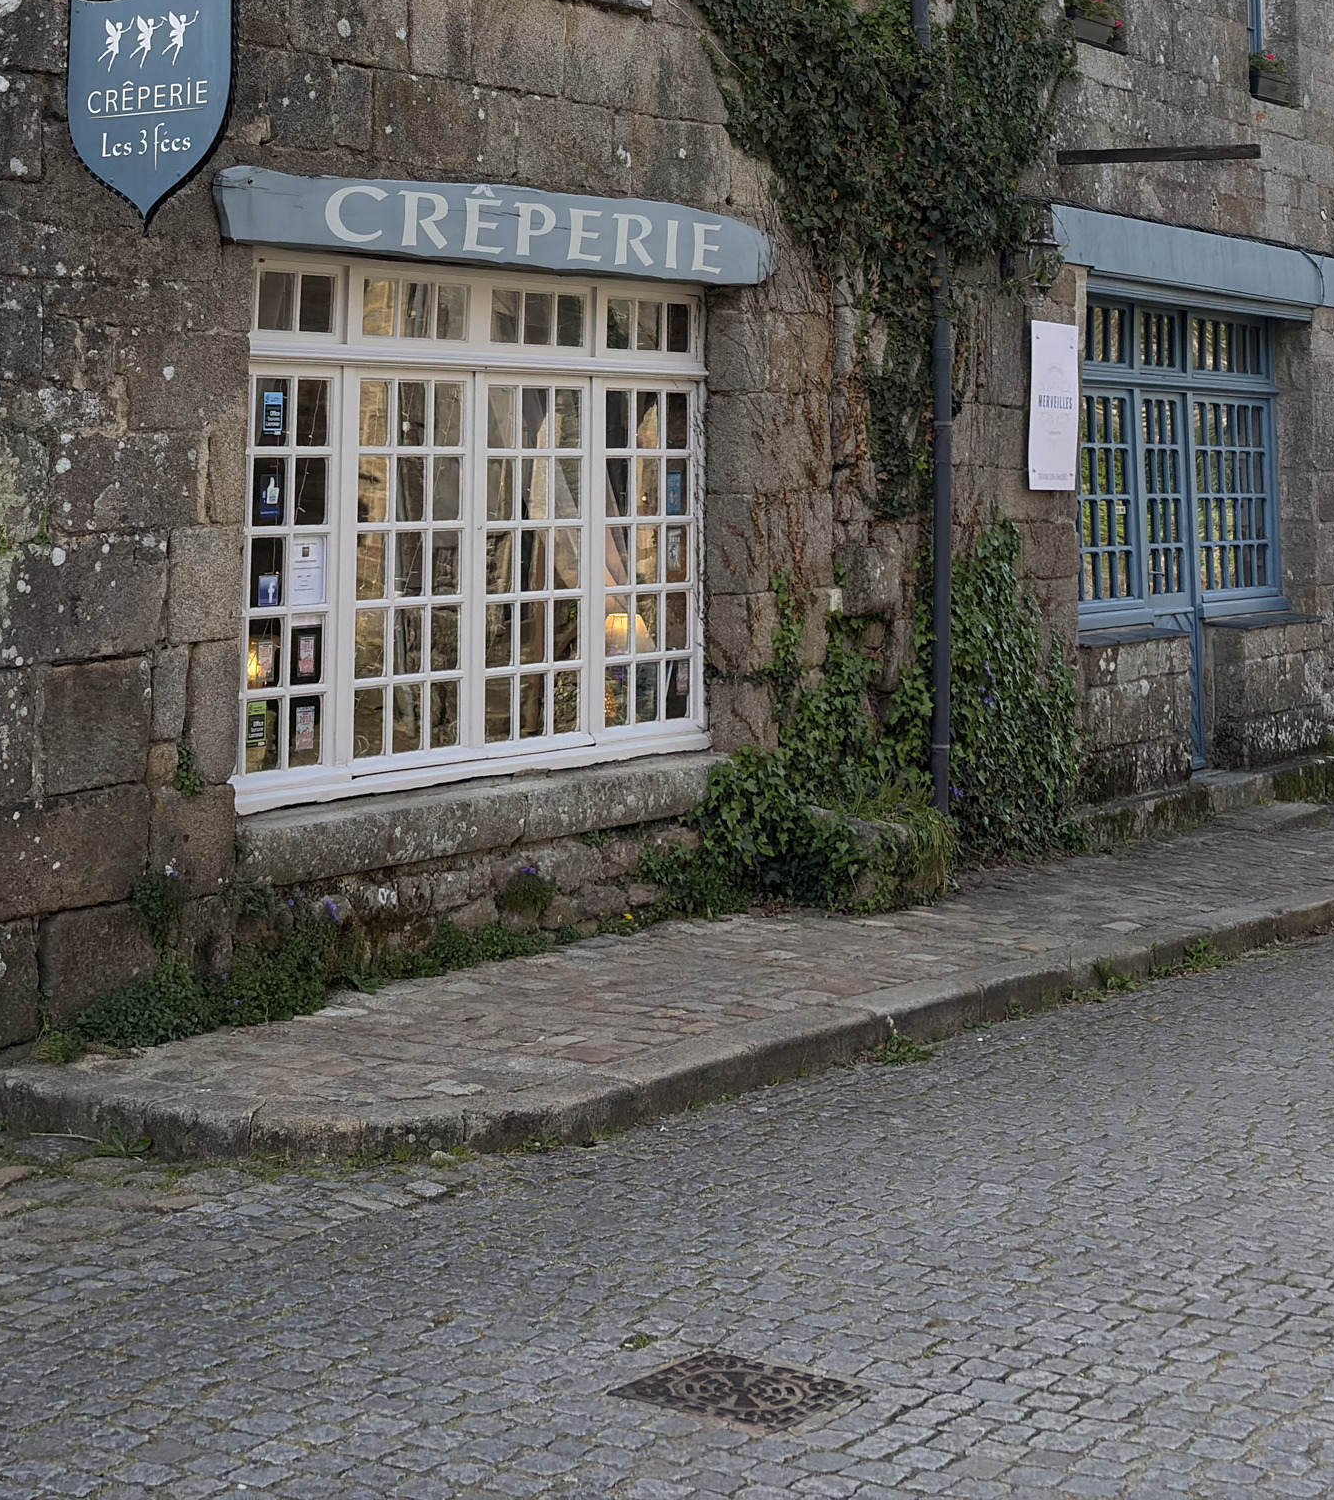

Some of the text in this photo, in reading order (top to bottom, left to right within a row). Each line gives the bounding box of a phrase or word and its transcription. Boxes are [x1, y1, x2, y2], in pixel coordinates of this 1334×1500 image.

[101, 122, 191, 171] Les 3 fées
[324, 184, 723, 274] CRÊPERIE
[1038, 394, 1073, 410] MERVEILLES
